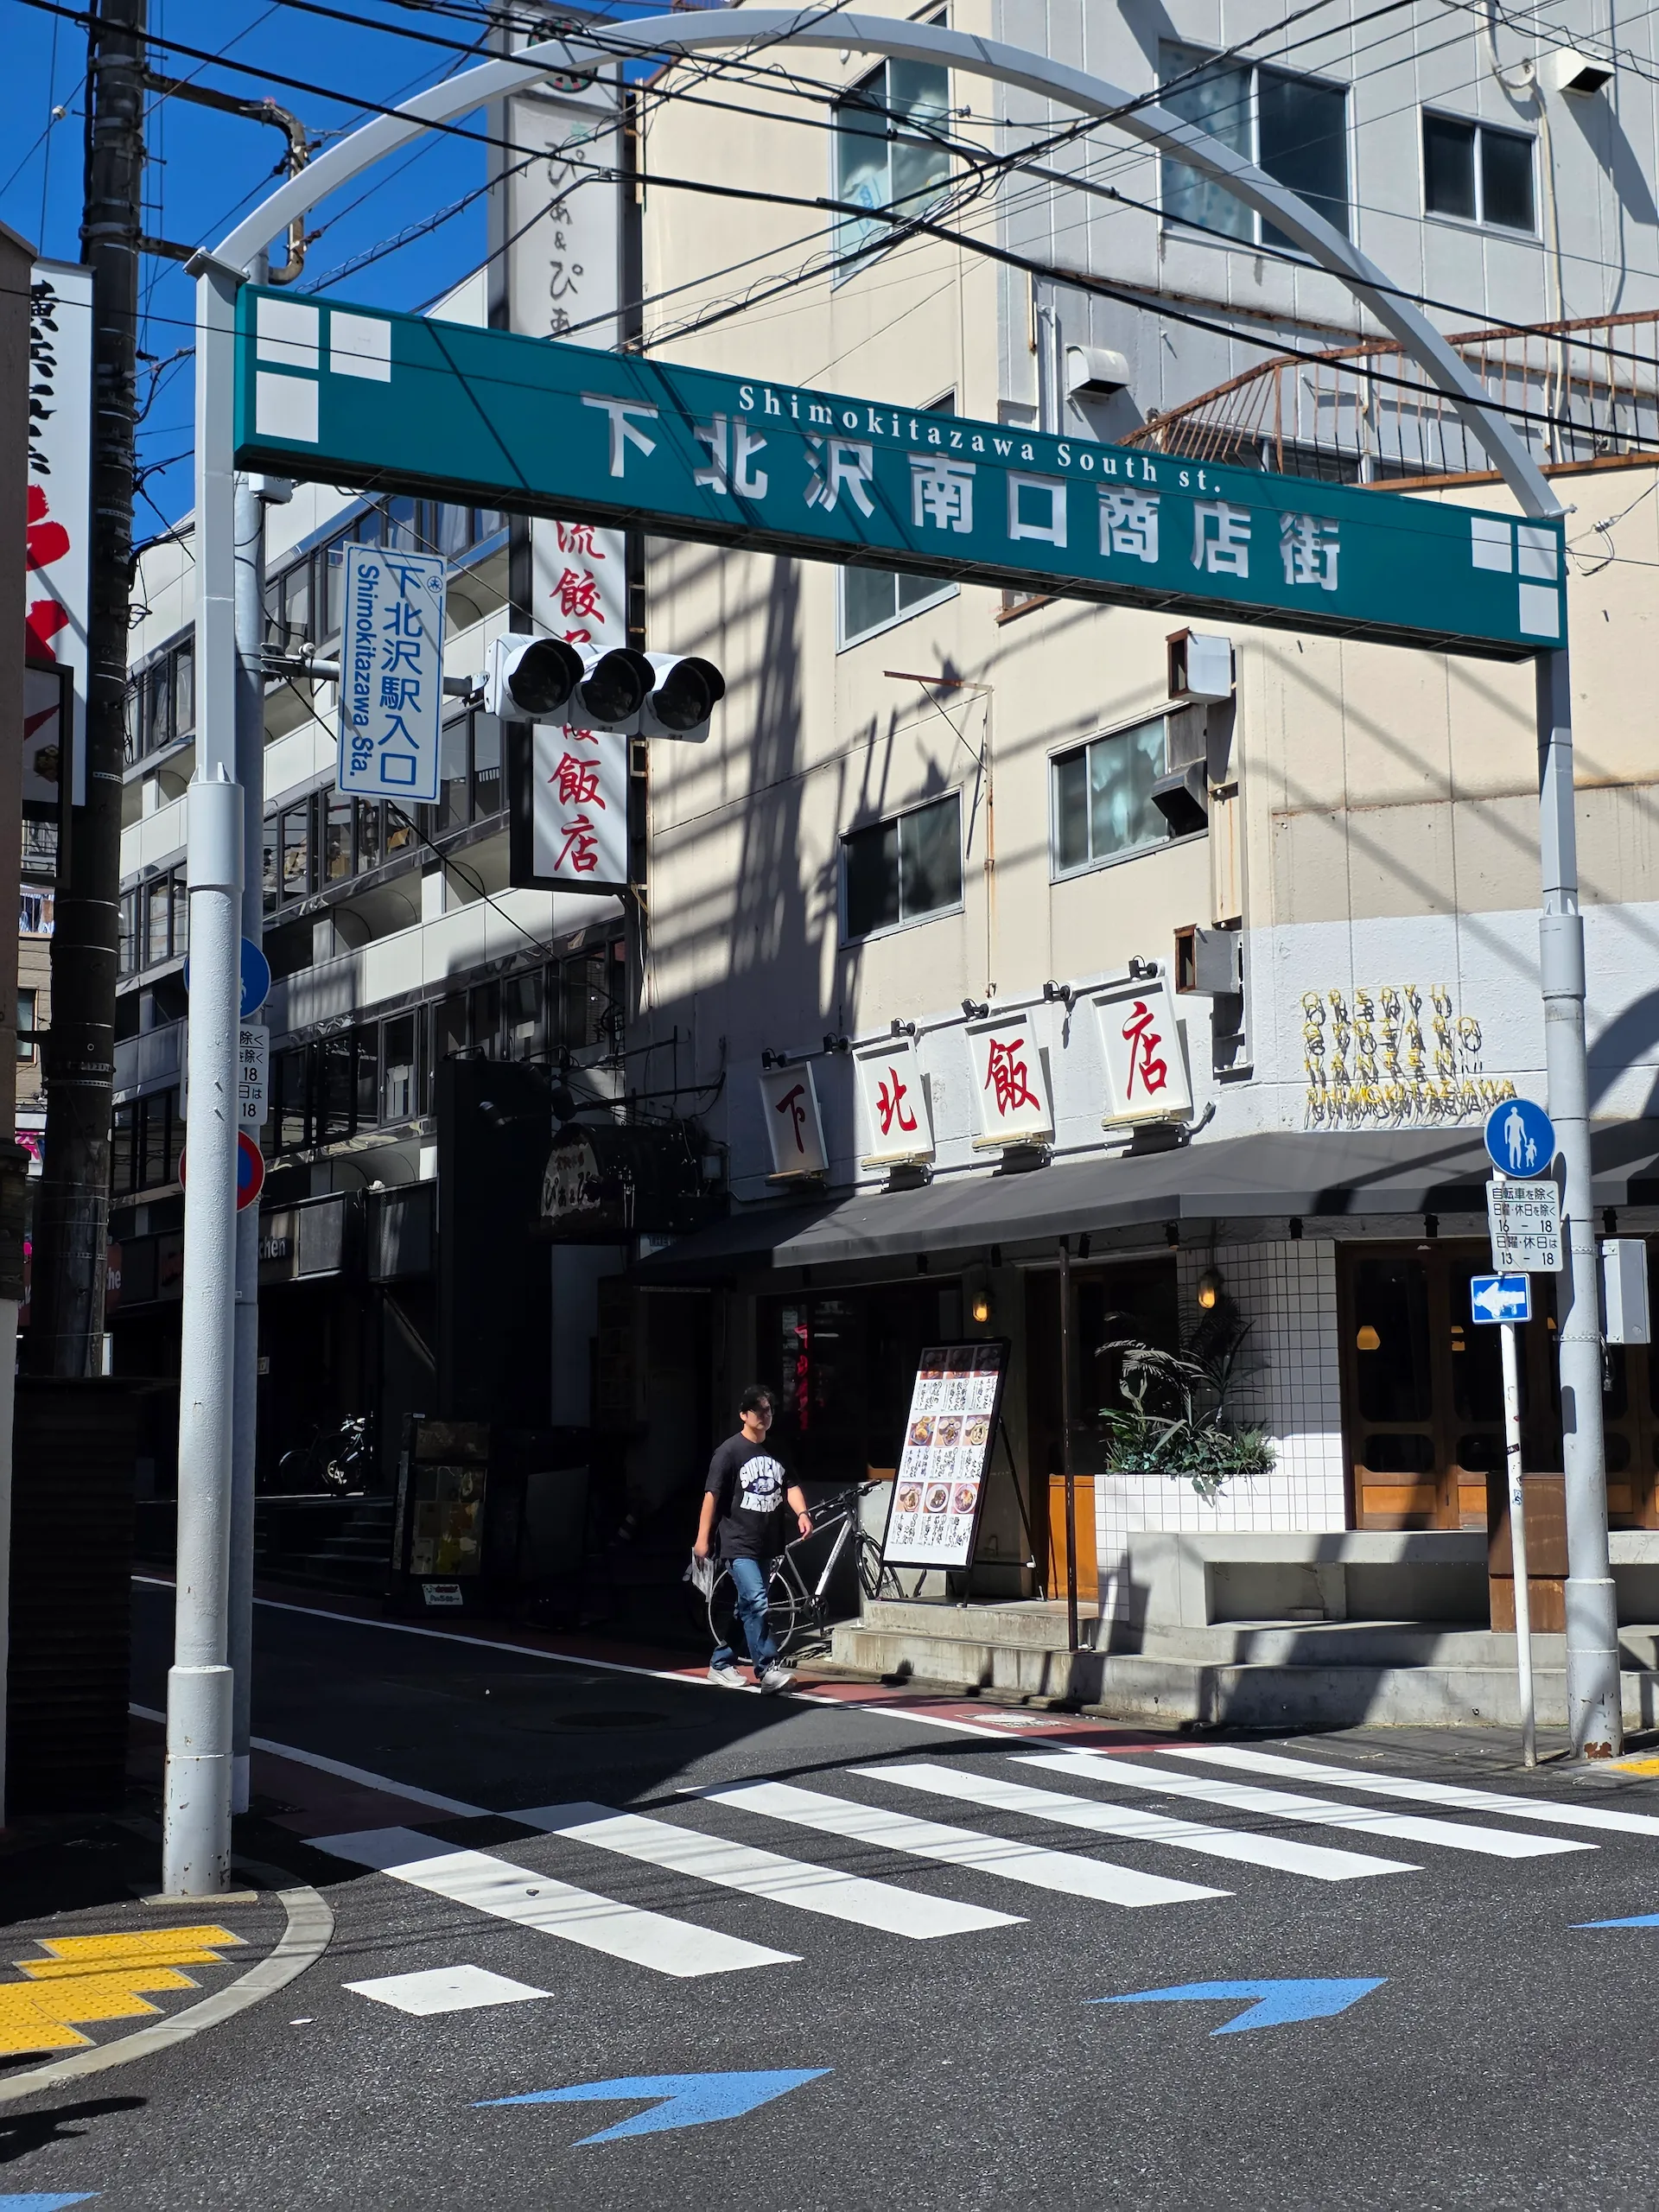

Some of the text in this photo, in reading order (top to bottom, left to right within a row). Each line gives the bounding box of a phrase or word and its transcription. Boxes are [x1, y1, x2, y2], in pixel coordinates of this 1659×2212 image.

[737, 384, 1223, 493] Shimokitazawa South st.
[580, 391, 1340, 592] 下北沢南口商店街
[349, 563, 380, 778] Shimokitazawa Sta.
[378, 563, 426, 786] 下北沢駅入口
[244, 1067, 257, 1082] 18
[243, 1103, 257, 1117] 18
[1492, 1187, 1554, 1200] 自転車を除く
[1498, 1219, 1510, 1232] 16
[1541, 1220, 1553, 1232] 18
[1501, 1252, 1513, 1264] 13
[1542, 1252, 1554, 1265] 18
